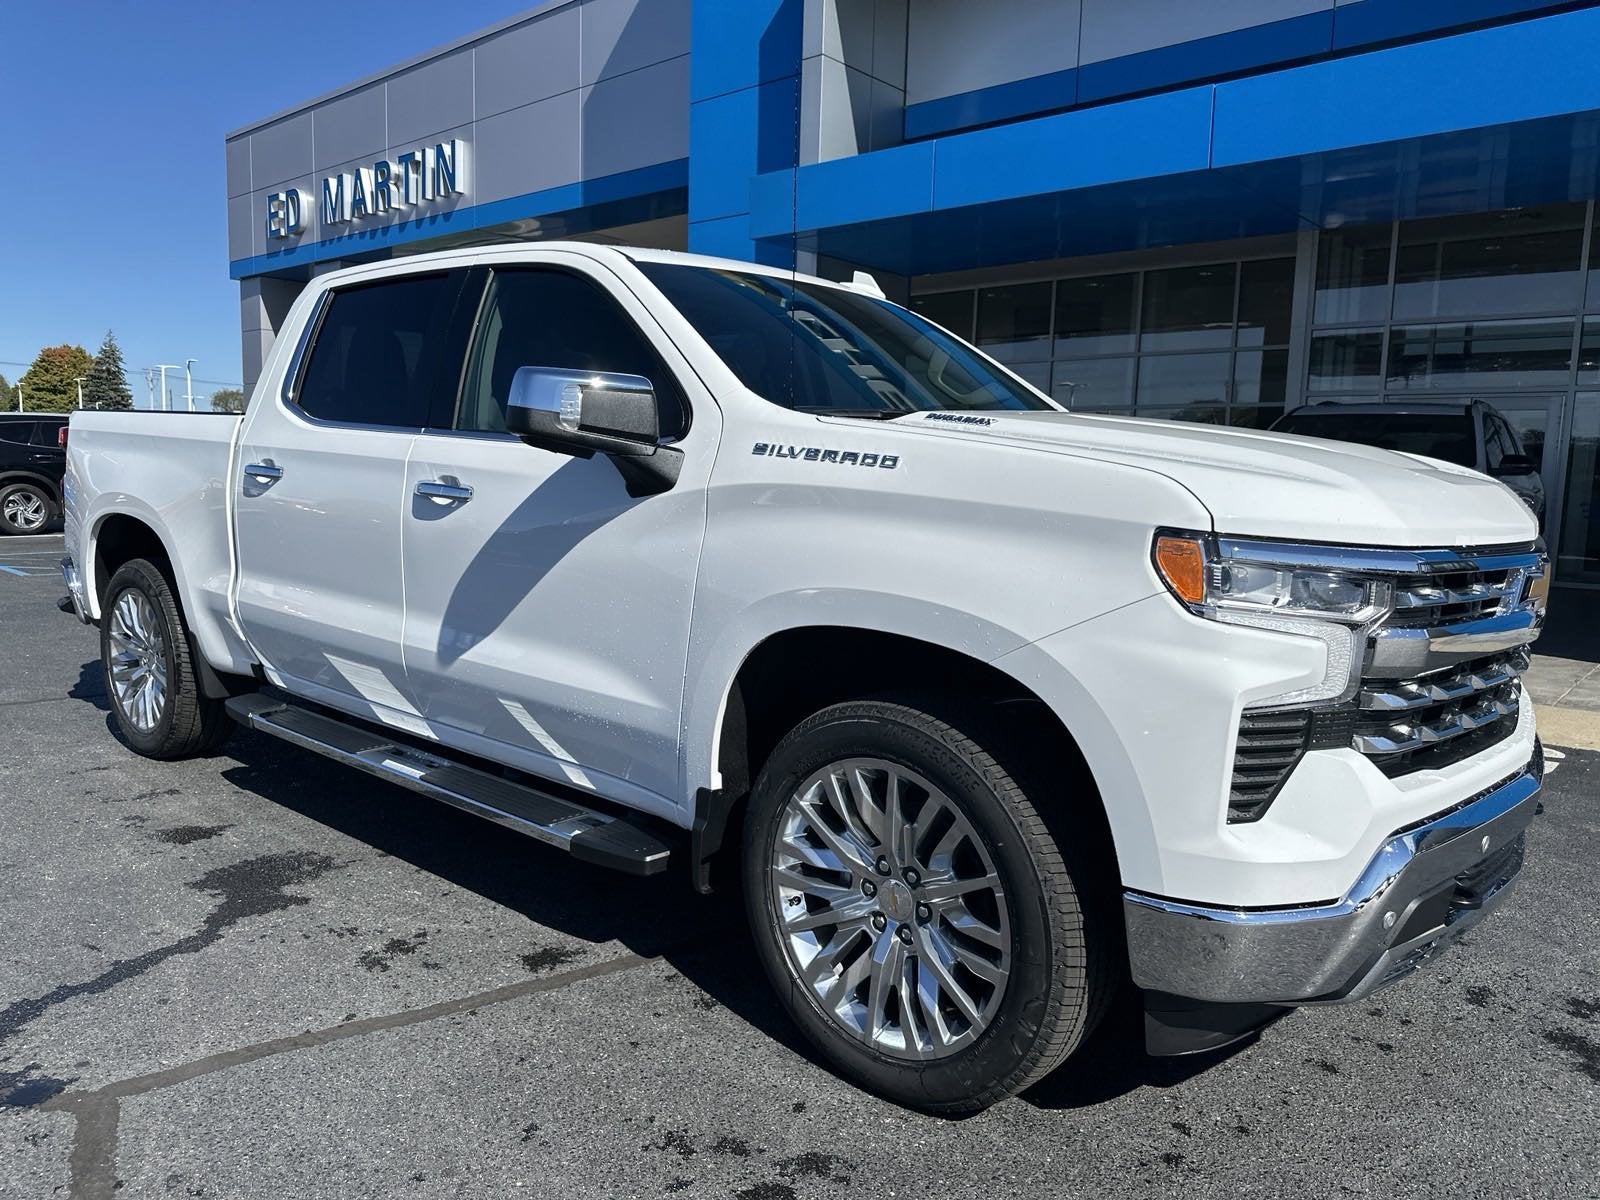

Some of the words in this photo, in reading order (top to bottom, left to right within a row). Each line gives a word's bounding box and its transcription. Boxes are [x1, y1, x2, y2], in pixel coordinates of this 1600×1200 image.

[267, 187, 306, 238] ED
[322, 138, 464, 225] MARTIN
[751, 441, 901, 470] SILVERADO
